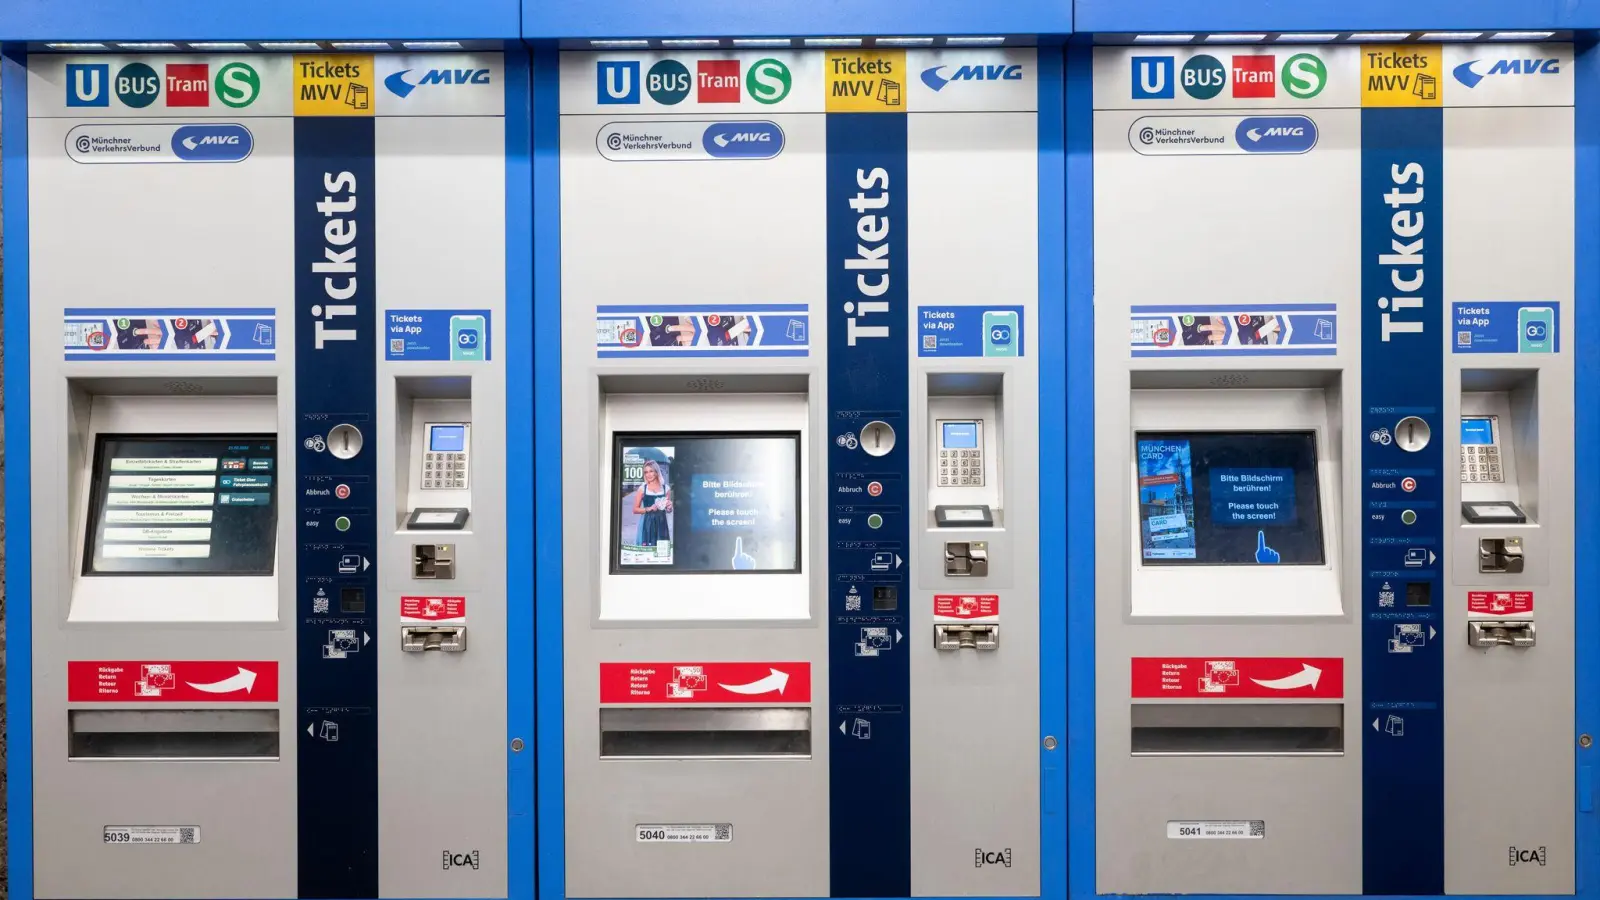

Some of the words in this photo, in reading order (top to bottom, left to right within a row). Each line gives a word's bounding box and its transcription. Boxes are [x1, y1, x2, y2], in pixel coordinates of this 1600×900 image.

[832, 58, 892, 75] Tickets
[1368, 52, 1428, 69] Tickets
[1488, 58, 1560, 74] MVG
[300, 62, 360, 79] Tickets
[949, 65, 1022, 81] MVG
[1140, 62, 1165, 93] U
[1183, 68, 1223, 86] BUS
[1233, 68, 1274, 83] Tram
[1290, 57, 1318, 95] S
[418, 69, 490, 85] MVG
[606, 68, 630, 98] U
[651, 73, 688, 91] BUS
[699, 73, 739, 88] Tram
[754, 62, 782, 100] S
[1368, 74, 1410, 91] MVV
[76, 70, 98, 100] U
[118, 76, 157, 94] BUS
[167, 76, 208, 91] Tram
[223, 66, 251, 104] S
[833, 80, 874, 96] MVV
[301, 84, 342, 100] MVV
[731, 133, 770, 141] MVG
[1264, 127, 1304, 136] MVG
[199, 136, 239, 145] MVG
[844, 167, 889, 346] Tickets
[1378, 162, 1424, 341] Tickets
[311, 171, 357, 349] Tickets
[937, 322, 954, 330] App
[1472, 318, 1489, 326] App
[405, 326, 422, 334] App
[992, 330, 1009, 340] GO
[1527, 326, 1545, 336] GO
[459, 334, 476, 344] GO
[1141, 444, 1180, 452] MÜNCHEN
[624, 467, 643, 478] 100
[104, 833, 130, 842] 5039
[640, 831, 665, 839] 5040
[450, 854, 473, 866] ICA
[982, 852, 1005, 864] ICA
[1516, 850, 1540, 862] ICA
